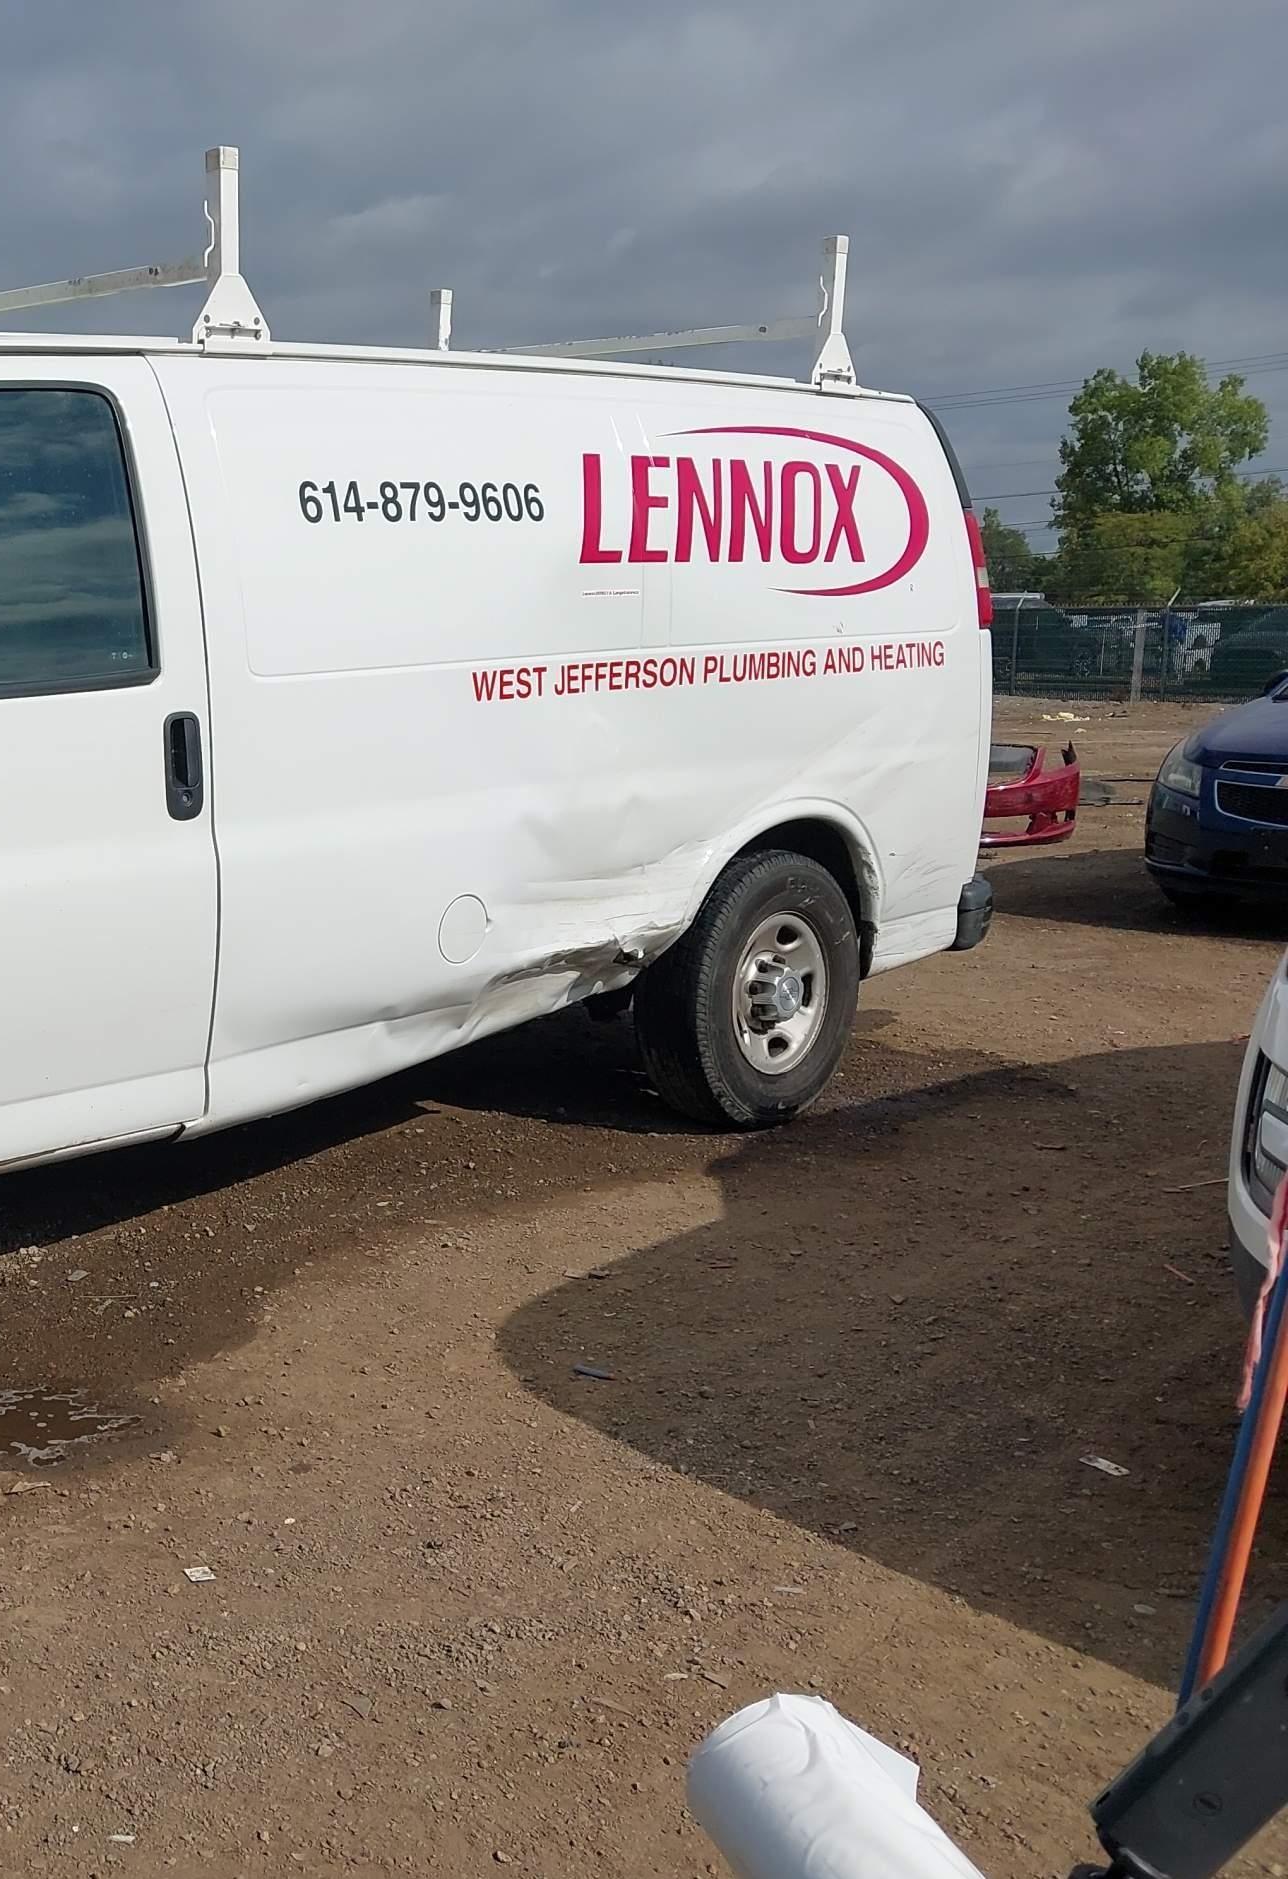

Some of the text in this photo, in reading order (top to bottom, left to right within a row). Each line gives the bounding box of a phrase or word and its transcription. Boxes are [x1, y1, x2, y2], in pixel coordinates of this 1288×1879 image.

[299, 480, 546, 523] 614-879-9606
[579, 453, 865, 564] LENNOX
[472, 640, 945, 701] WEST JEFFERSON PLUMBING AND HEATING
